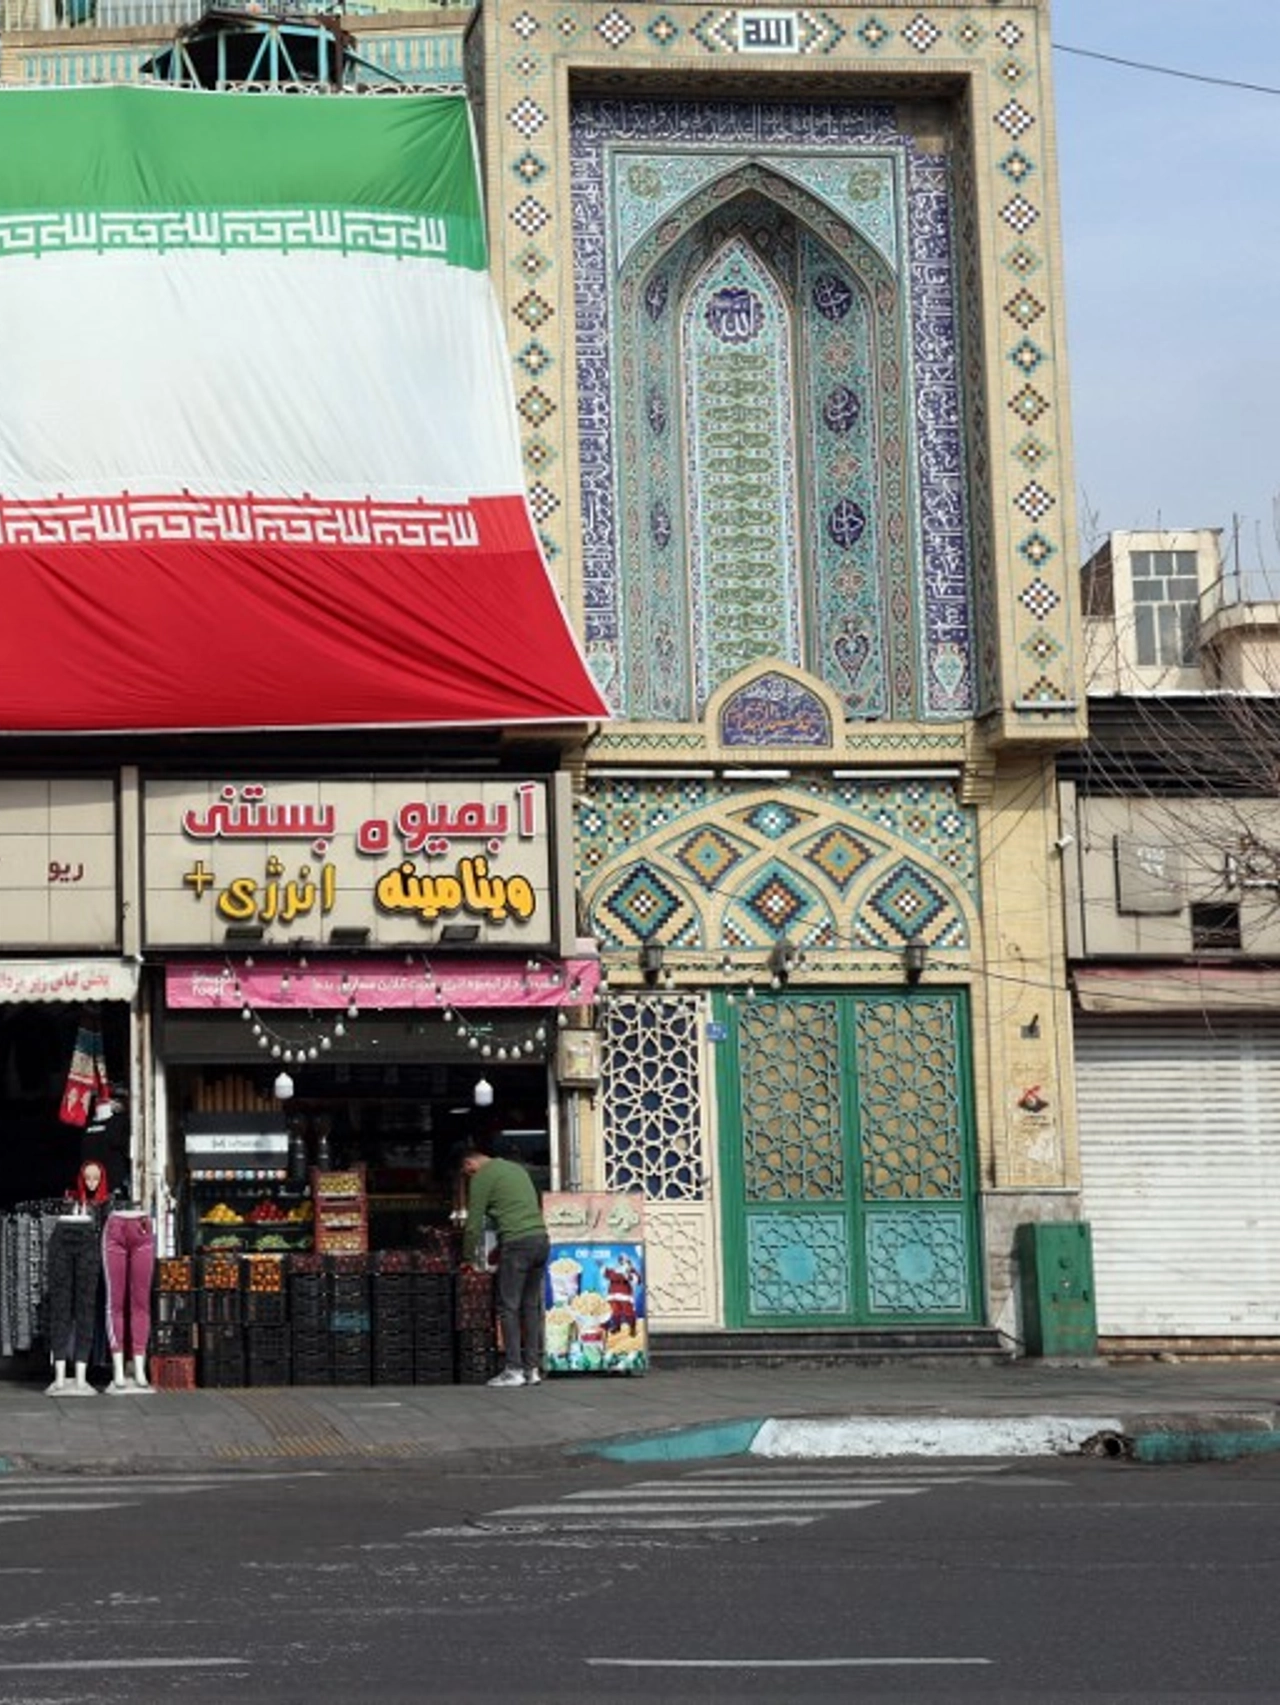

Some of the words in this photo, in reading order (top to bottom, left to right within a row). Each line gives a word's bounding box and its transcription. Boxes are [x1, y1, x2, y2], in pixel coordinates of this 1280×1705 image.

[184, 784, 336, 853] بستنی
[357, 782, 536, 853] آبمیوه
[47, 860, 84, 883] ریو
[218, 855, 336, 922] انرژی
[376, 856, 536, 922] ویتامینه
